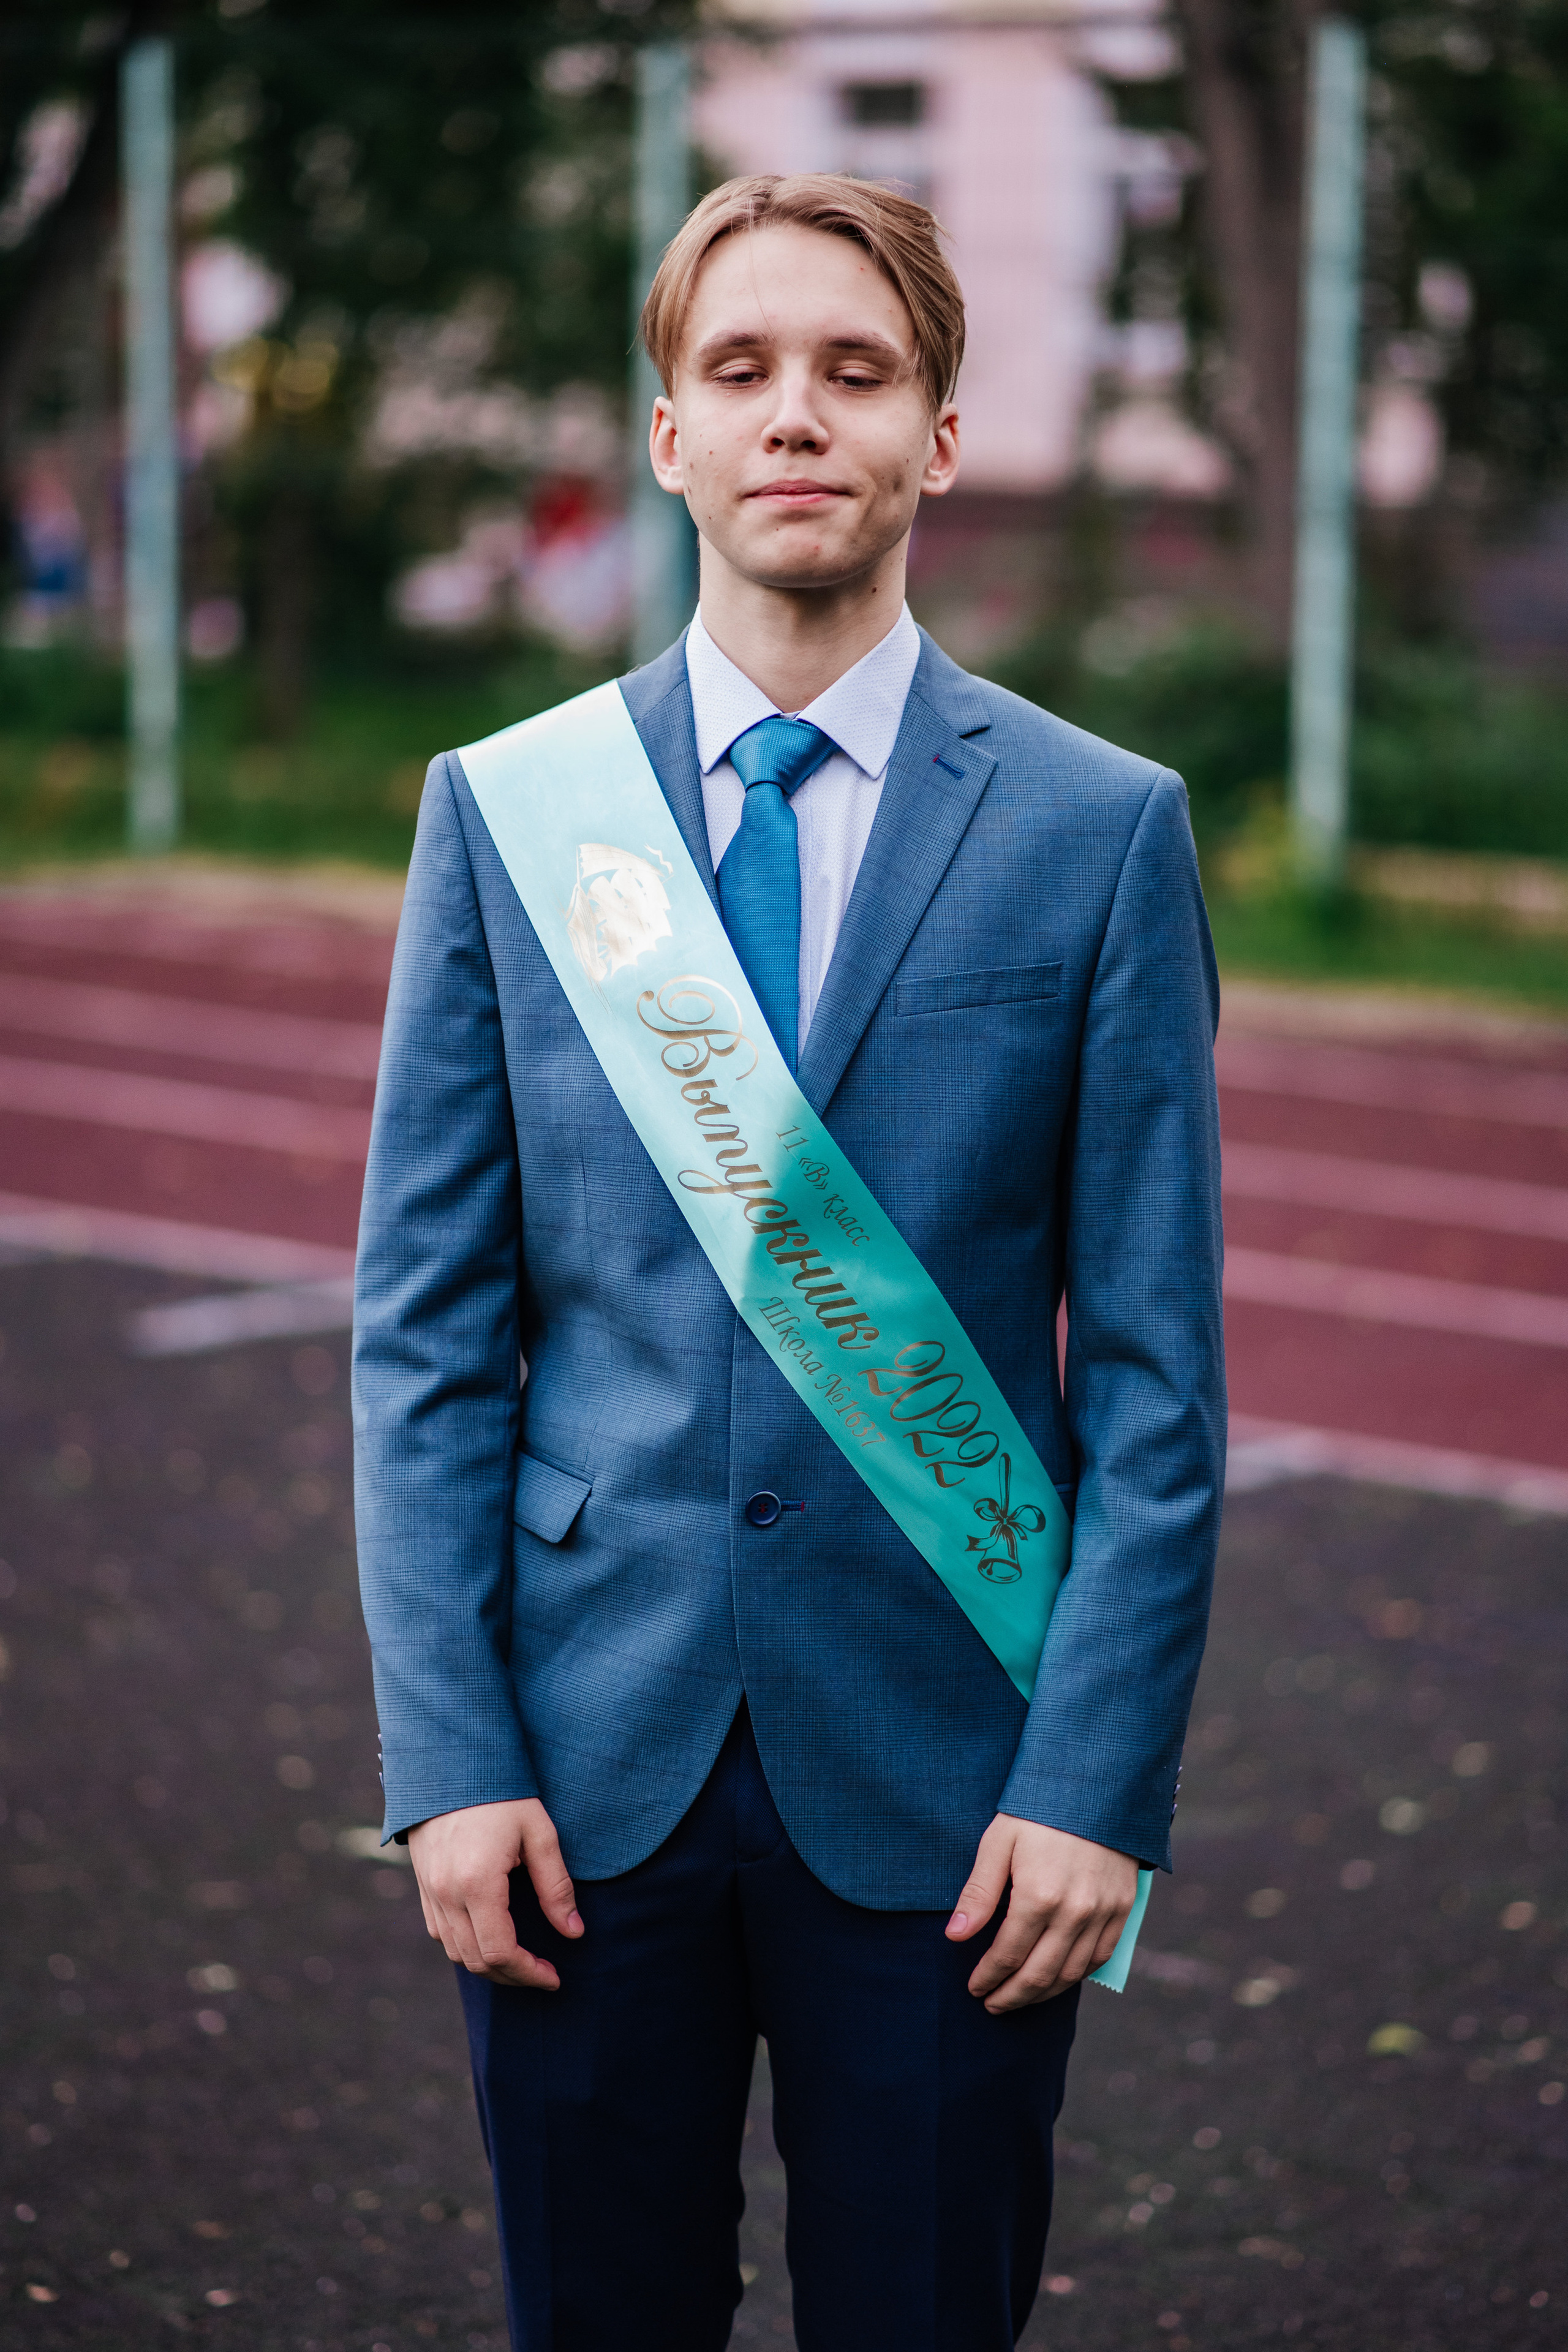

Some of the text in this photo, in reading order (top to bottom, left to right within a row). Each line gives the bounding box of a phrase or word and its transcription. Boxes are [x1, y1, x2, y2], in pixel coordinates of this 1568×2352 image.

[636, 974, 1000, 1488] Выпускник 2022
[775, 1125, 870, 1247] 11 «В» класс
[758, 1296, 886, 1447] Школа №1637
